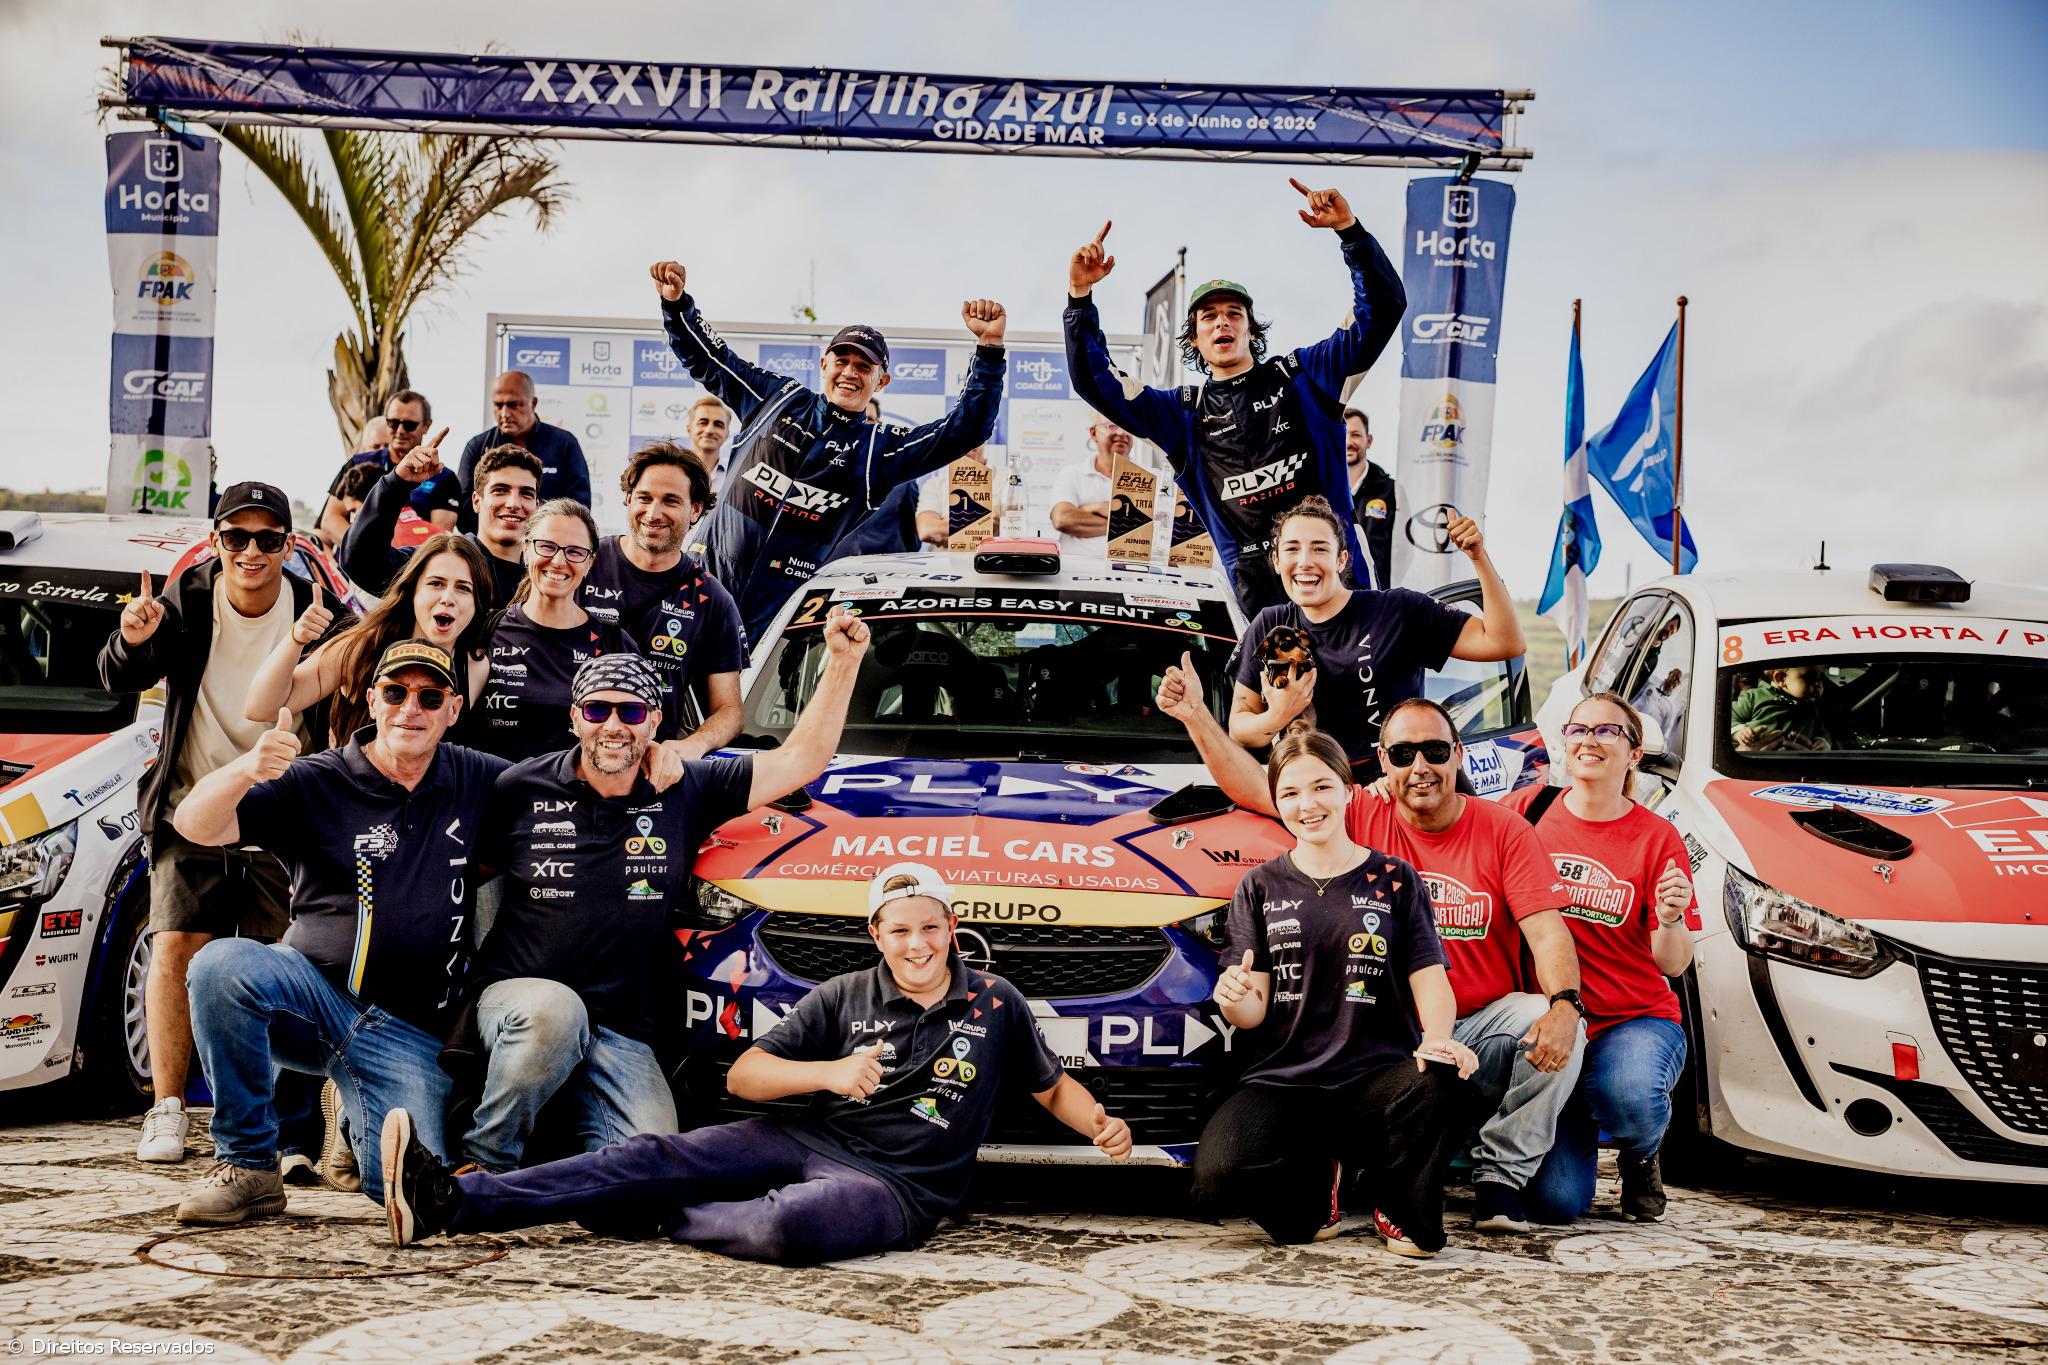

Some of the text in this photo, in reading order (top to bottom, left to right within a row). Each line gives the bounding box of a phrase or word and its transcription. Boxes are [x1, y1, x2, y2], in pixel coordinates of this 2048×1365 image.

[521, 61, 1115, 125] XXXVII Rali Ilha Azul
[1116, 111, 1316, 131] 5 a 6 de Junho de 2026
[932, 120, 1104, 145] CIDADE MAR
[118, 184, 209, 213] Horta
[1416, 230, 1496, 260] Horta
[138, 280, 195, 300] FPAK
[581, 362, 622, 375] Horta
[640, 372, 668, 380] CIDADE
[1015, 383, 1044, 391] CIDADE
[1420, 423, 1466, 444] FPAK
[1118, 475, 1154, 485] RALI
[131, 488, 191, 510] FPAK
[961, 496, 968, 510] 1
[973, 492, 990, 502] CAR
[1239, 481, 1297, 507] RACING
[753, 490, 821, 522] RACING
[1123, 502, 1130, 516] 1
[1187, 508, 1194, 523] 1
[1185, 543, 1213, 551] ABSOLUTO
[788, 556, 816, 570] Nuno
[27, 580, 109, 602] Estrela
[674, 608, 696, 617] GRUPO
[794, 597, 826, 624] 2
[880, 597, 1155, 620] AZORES EASY RENT
[1763, 627, 1841, 645] ERA
[1846, 626, 1982, 641] HORTA
[1996, 629, 2009, 645] /
[1723, 635, 1743, 664] 8
[485, 690, 520, 709] XTC
[1469, 748, 1501, 774] Azul
[84, 773, 124, 802] TRANSINSULAR
[1481, 773, 1501, 787] MAR
[531, 842, 556, 850] MACIEL
[831, 834, 1116, 868] MACIEL CARS
[529, 857, 575, 878] XTC
[625, 863, 668, 876] paulcar
[779, 858, 1161, 891] COMÉRCI VIATURAS USADAS
[1588, 867, 1610, 888] 2025
[1446, 883, 1466, 905] 2025
[950, 900, 1062, 923] GRUPO
[1368, 900, 1391, 910] GRUPO
[1434, 900, 1484, 926] ORTUGAL
[43, 911, 82, 930] ETS
[1570, 906, 1618, 924] DE PORTUGAL
[1445, 927, 1482, 936] PORTUGAL
[1283, 941, 1302, 949] CARS
[48, 952, 79, 964] WÜRTH
[1345, 963, 1383, 976] paulcar
[22, 1024, 51, 1033] HOPPER
[963, 1023, 987, 1033] GRUPO
[5, 1040, 32, 1049] Monopoly
